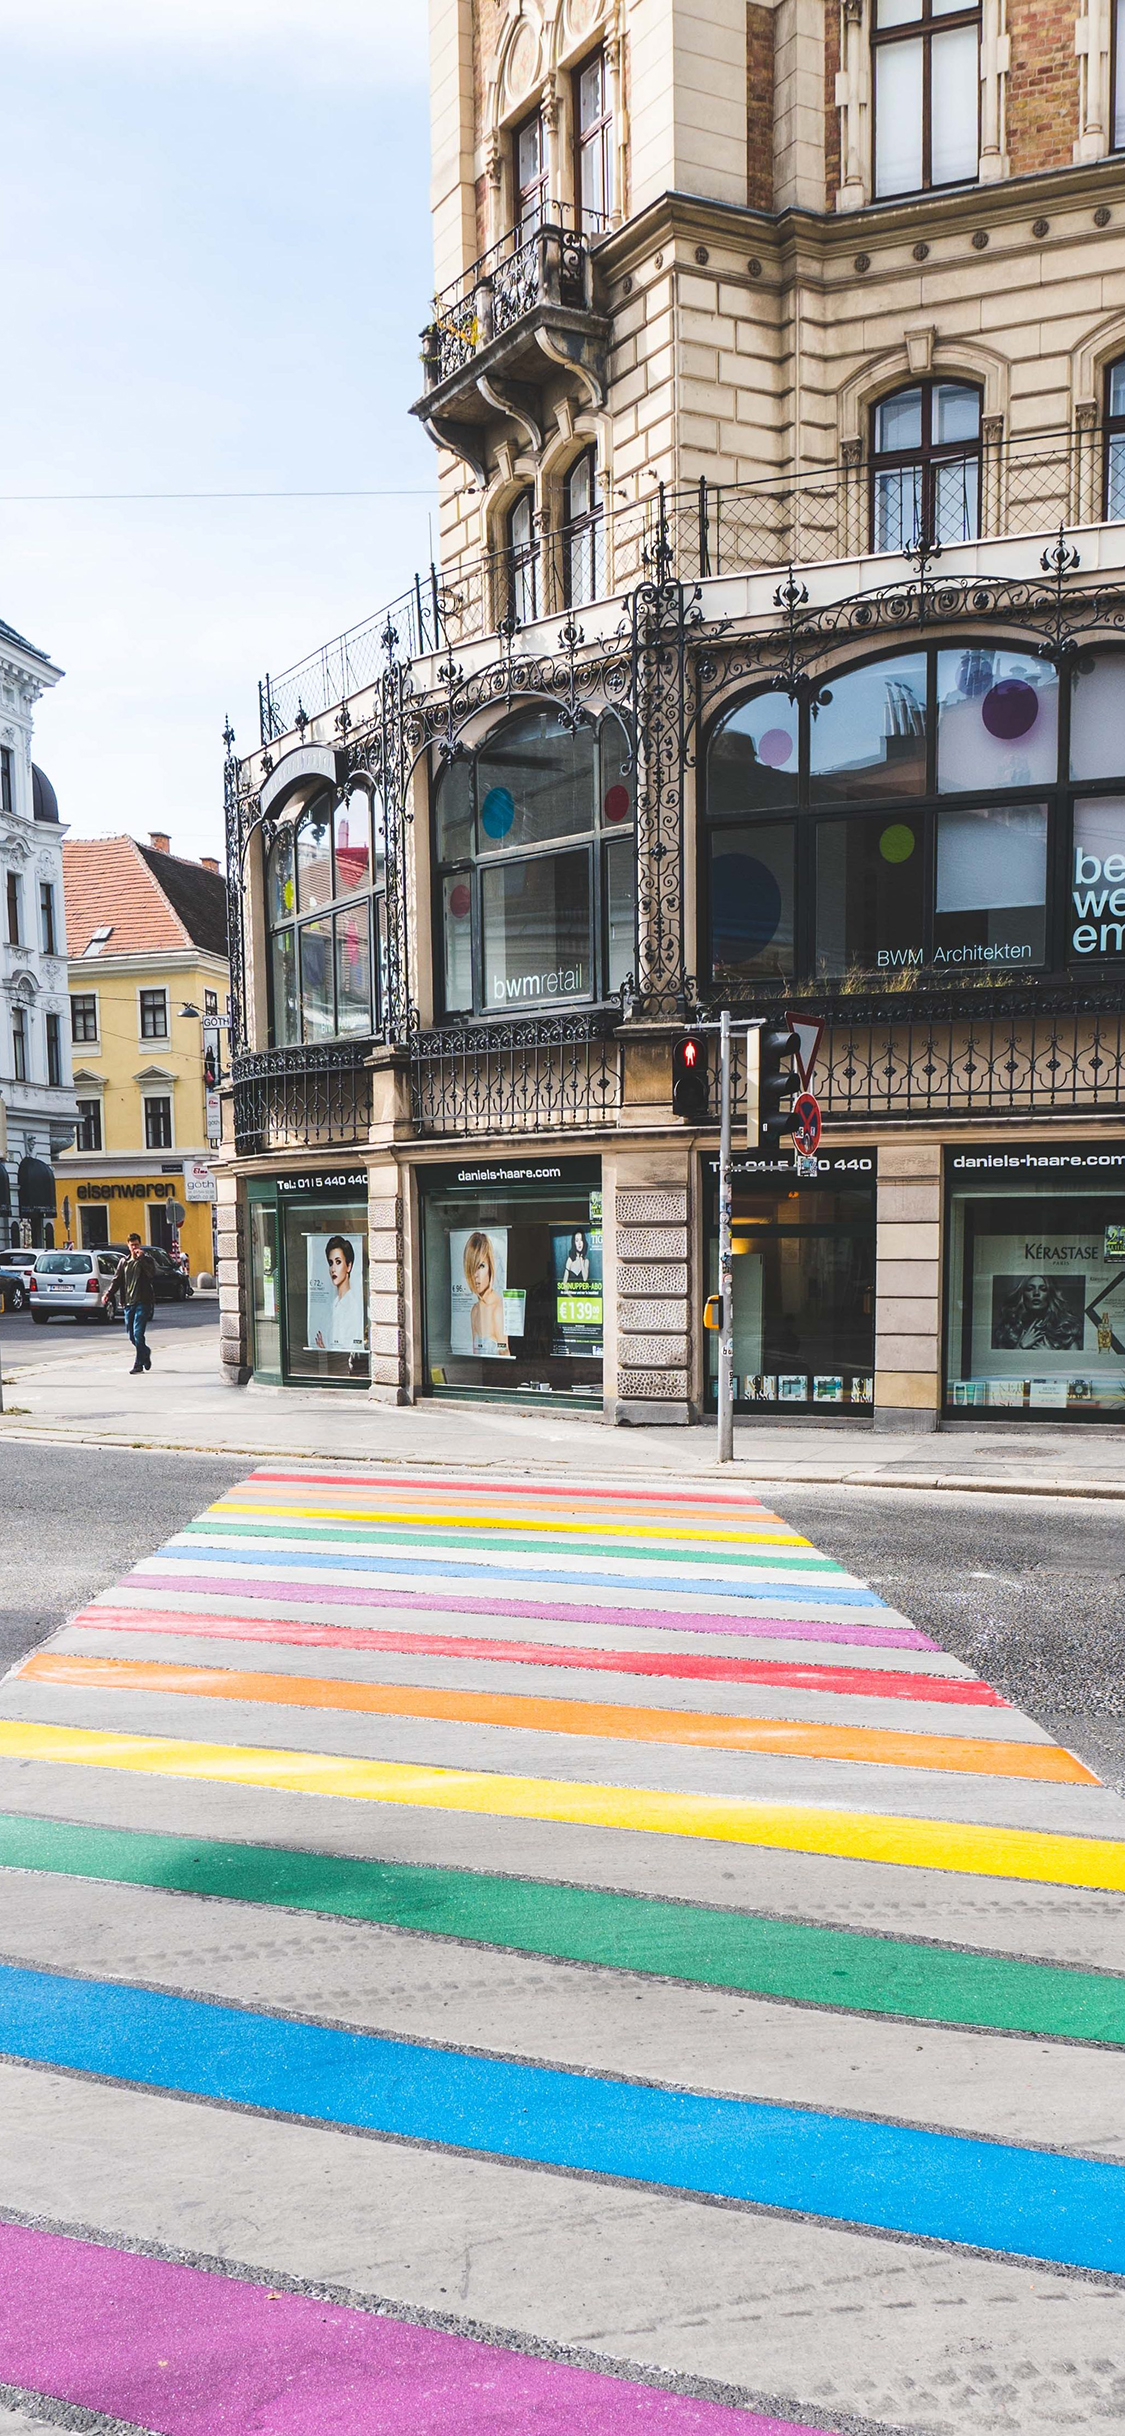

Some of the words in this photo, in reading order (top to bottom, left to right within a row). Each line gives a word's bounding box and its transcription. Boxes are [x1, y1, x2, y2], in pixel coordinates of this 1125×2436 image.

[1075, 847, 1125, 884] be
[877, 948, 923, 967] BWM
[933, 943, 1032, 962] Architekten
[493, 963, 582, 999] bwmretail
[834, 1159, 872, 1171] 440
[324, 1176, 346, 1186] 440
[77, 1182, 175, 1200] eisenwaren
[1025, 1243, 1098, 1260] KÉRASTASE
